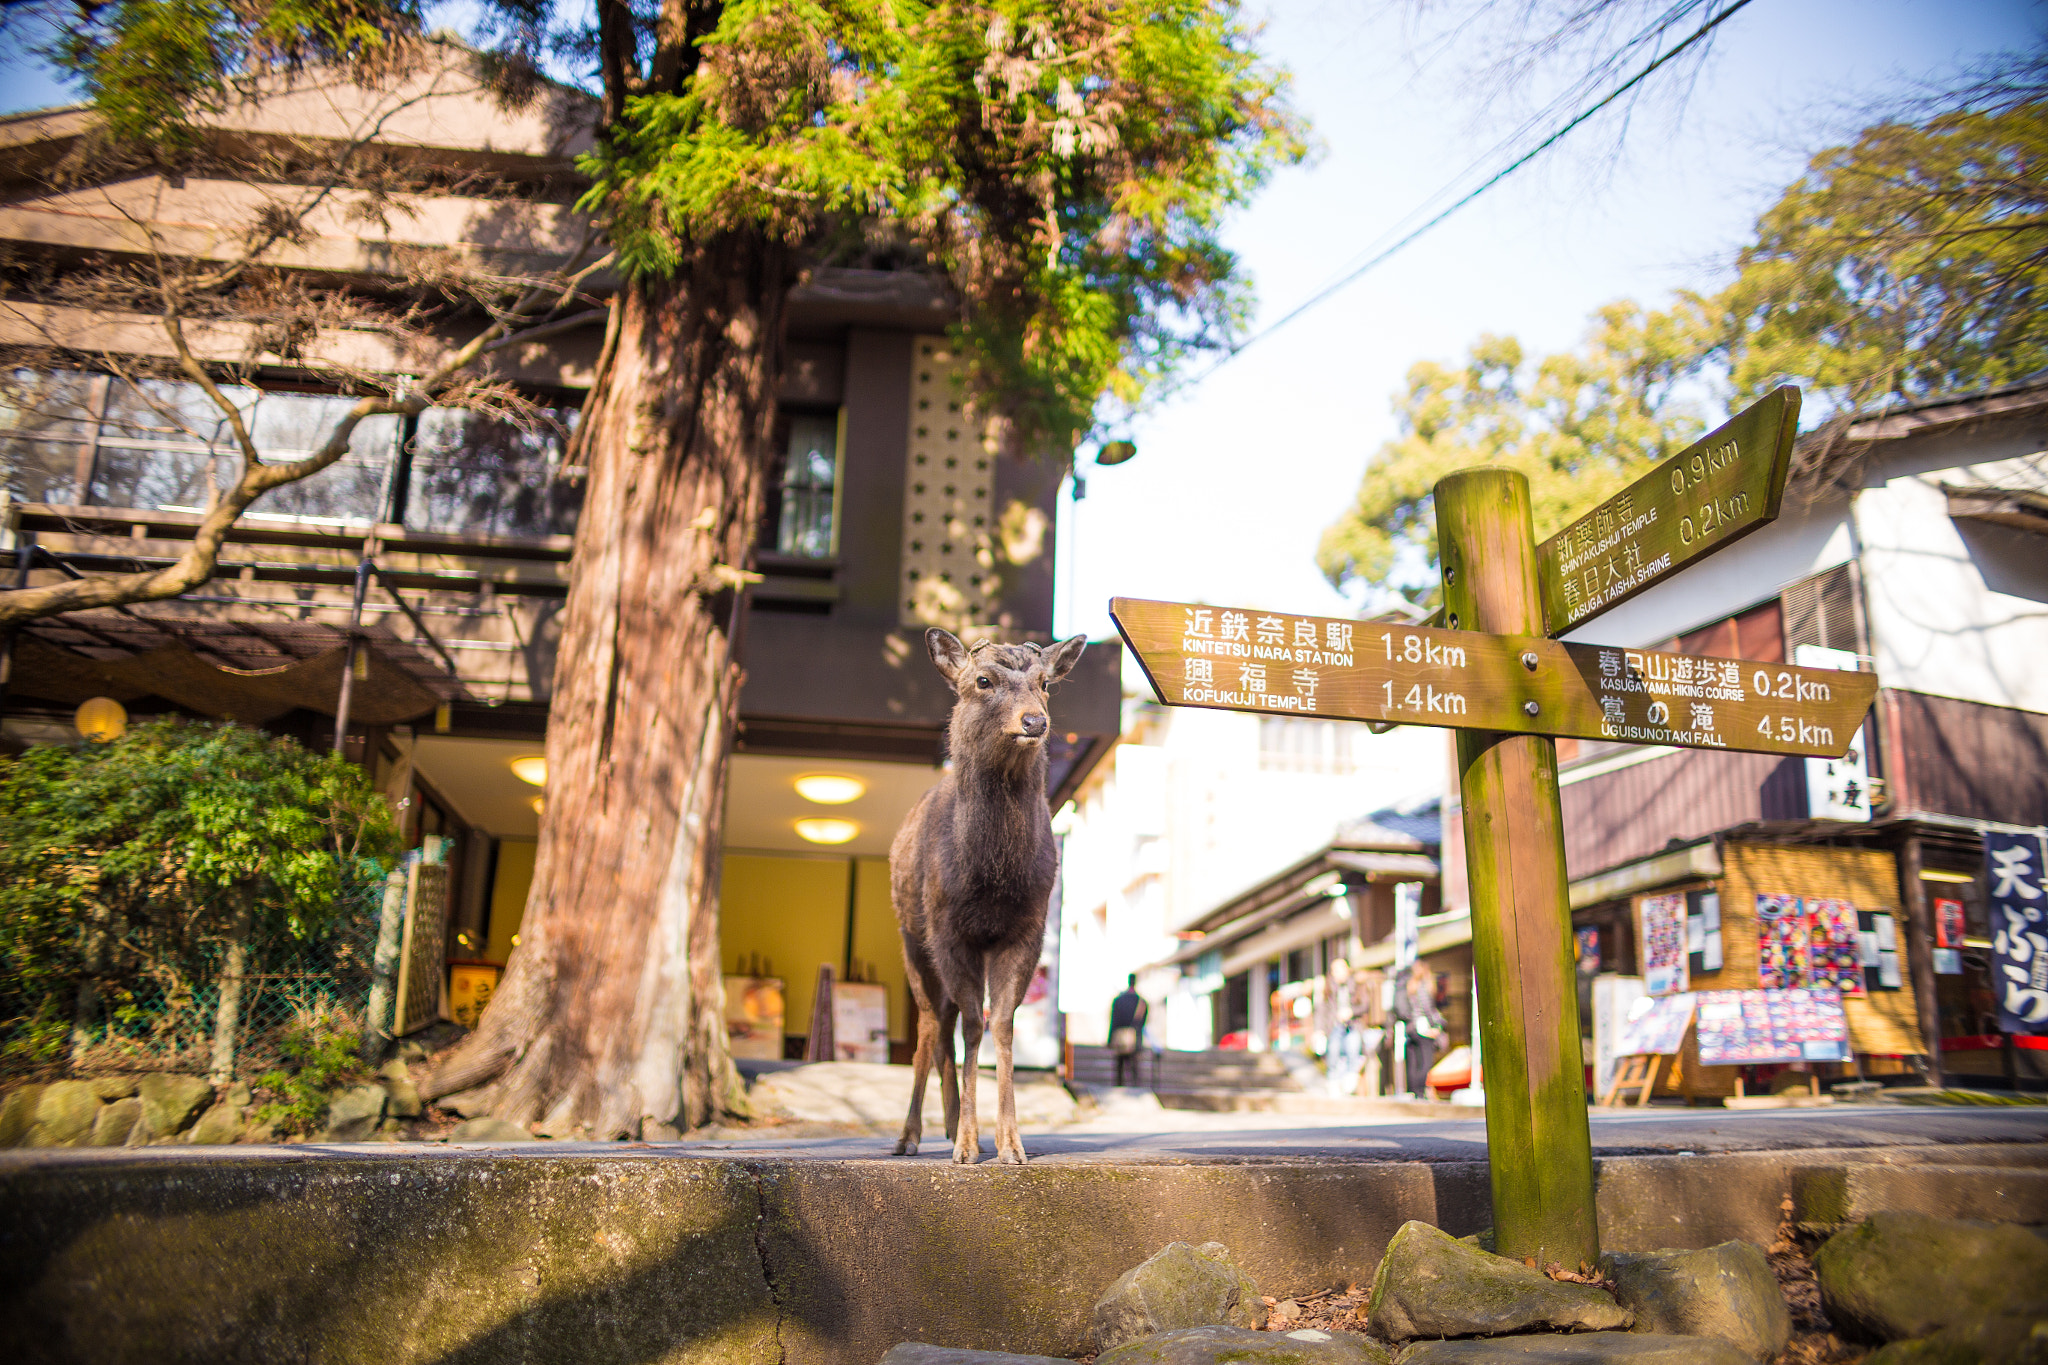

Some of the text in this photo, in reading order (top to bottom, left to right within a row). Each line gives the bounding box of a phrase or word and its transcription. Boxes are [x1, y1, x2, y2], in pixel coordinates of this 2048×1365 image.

[1671, 438, 1740, 496] 0.9km
[1557, 493, 1633, 562] 新薬師寺
[1679, 489, 1750, 546] 0.2km
[1560, 507, 1658, 577] SHINYAKUSHIJI TEMPLE
[1563, 540, 1644, 608] 春日大社
[1567, 552, 1672, 624] KASUGA TAISHA SHRINE
[1184, 607, 1354, 653] 近鉄奈良駅
[1380, 631, 1466, 669] 1.8km
[1182, 638, 1354, 668] KINTETSU NARA STATION
[1598, 649, 1741, 690] 春日山遊歩道
[1183, 687, 1317, 712] KOFUKUJI TEMPLE
[1382, 680, 1467, 716] 1.4km
[1600, 678, 1745, 702] KASUGAYAMA HIKING COURSE
[1752, 670, 1831, 702] 0.2km
[1601, 722, 1727, 747] UGUISUNOTAKI FALL
[1757, 714, 1834, 748] 4.5km
[1991, 844, 2048, 1024] 天ぷら
